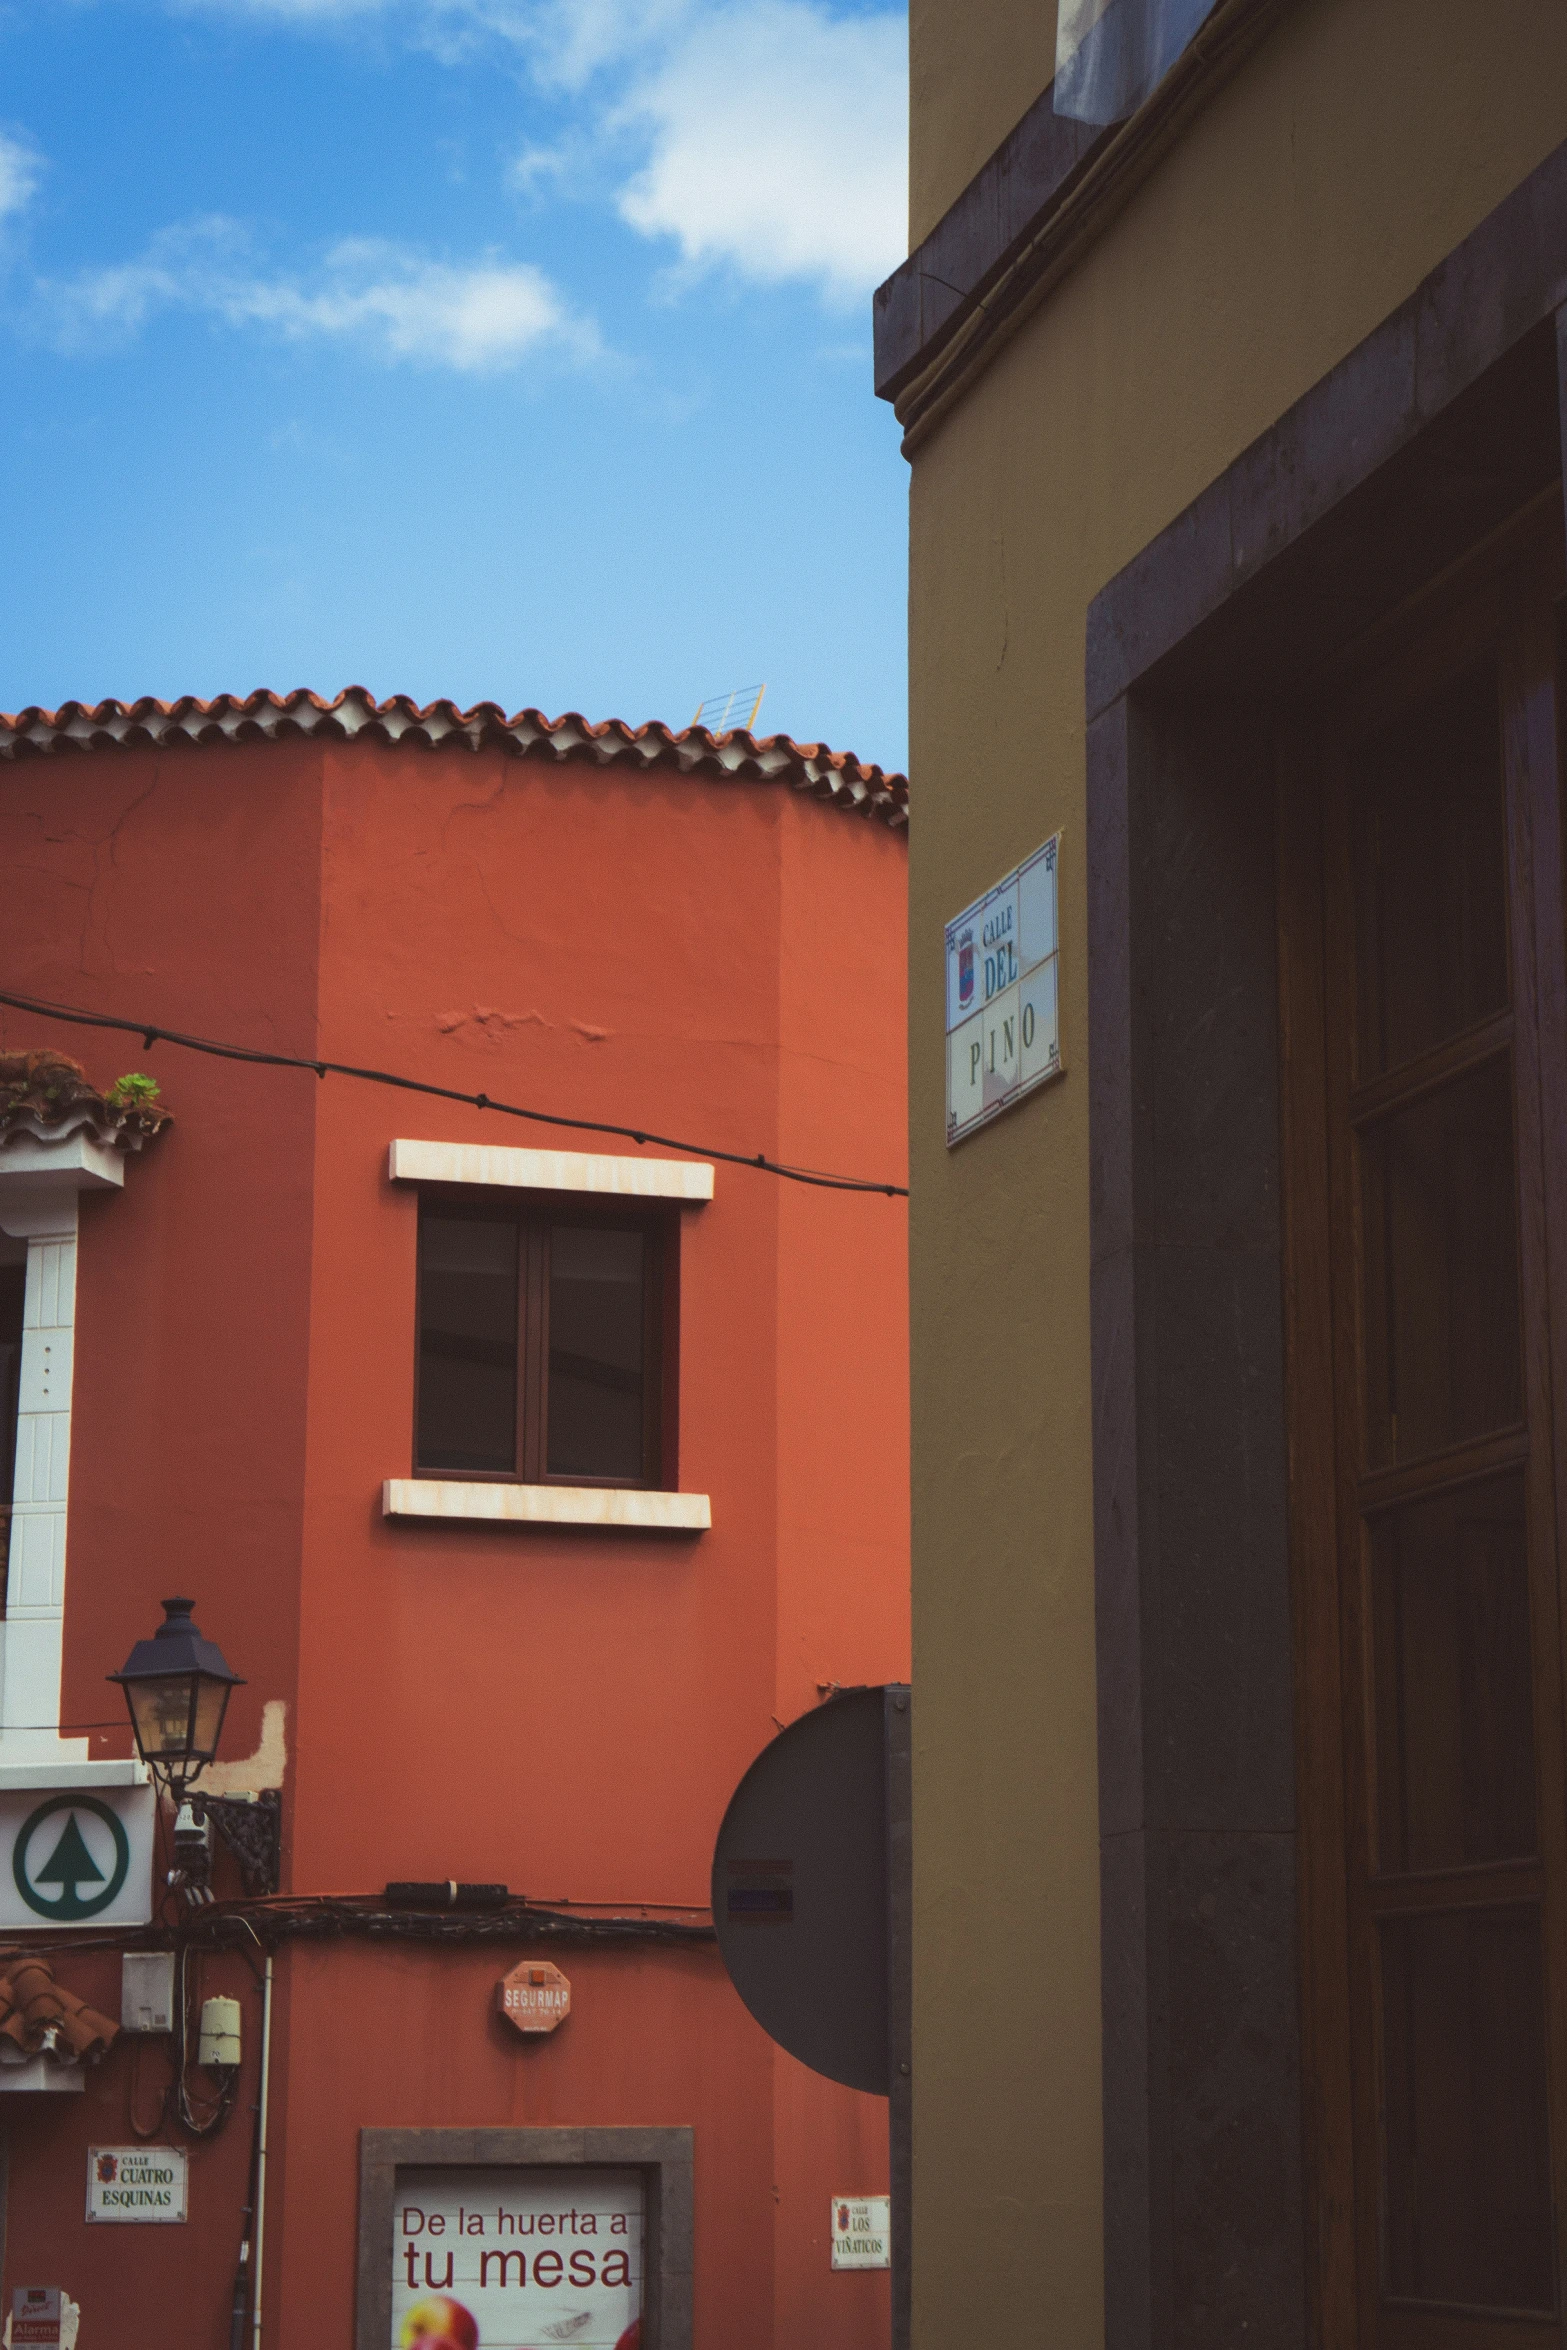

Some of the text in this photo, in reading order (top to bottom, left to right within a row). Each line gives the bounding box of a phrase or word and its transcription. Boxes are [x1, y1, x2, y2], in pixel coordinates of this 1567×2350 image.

[983, 905, 1013, 947] CALLE
[984, 940, 1018, 1001] DEL
[969, 1002, 1035, 1086] PINO
[505, 1989, 569, 2008] SEGURMAP
[122, 2156, 149, 2166] CALLE
[120, 2168, 174, 2184] CUATRO
[102, 2190, 171, 2208] ESQUINAS
[402, 2207, 628, 2236] De la huerta a
[852, 2217, 870, 2232] LOS
[836, 2236, 883, 2254] VIÑATICOS
[403, 2242, 633, 2289] tu mesa
[14, 2323, 59, 2335] Alarma
